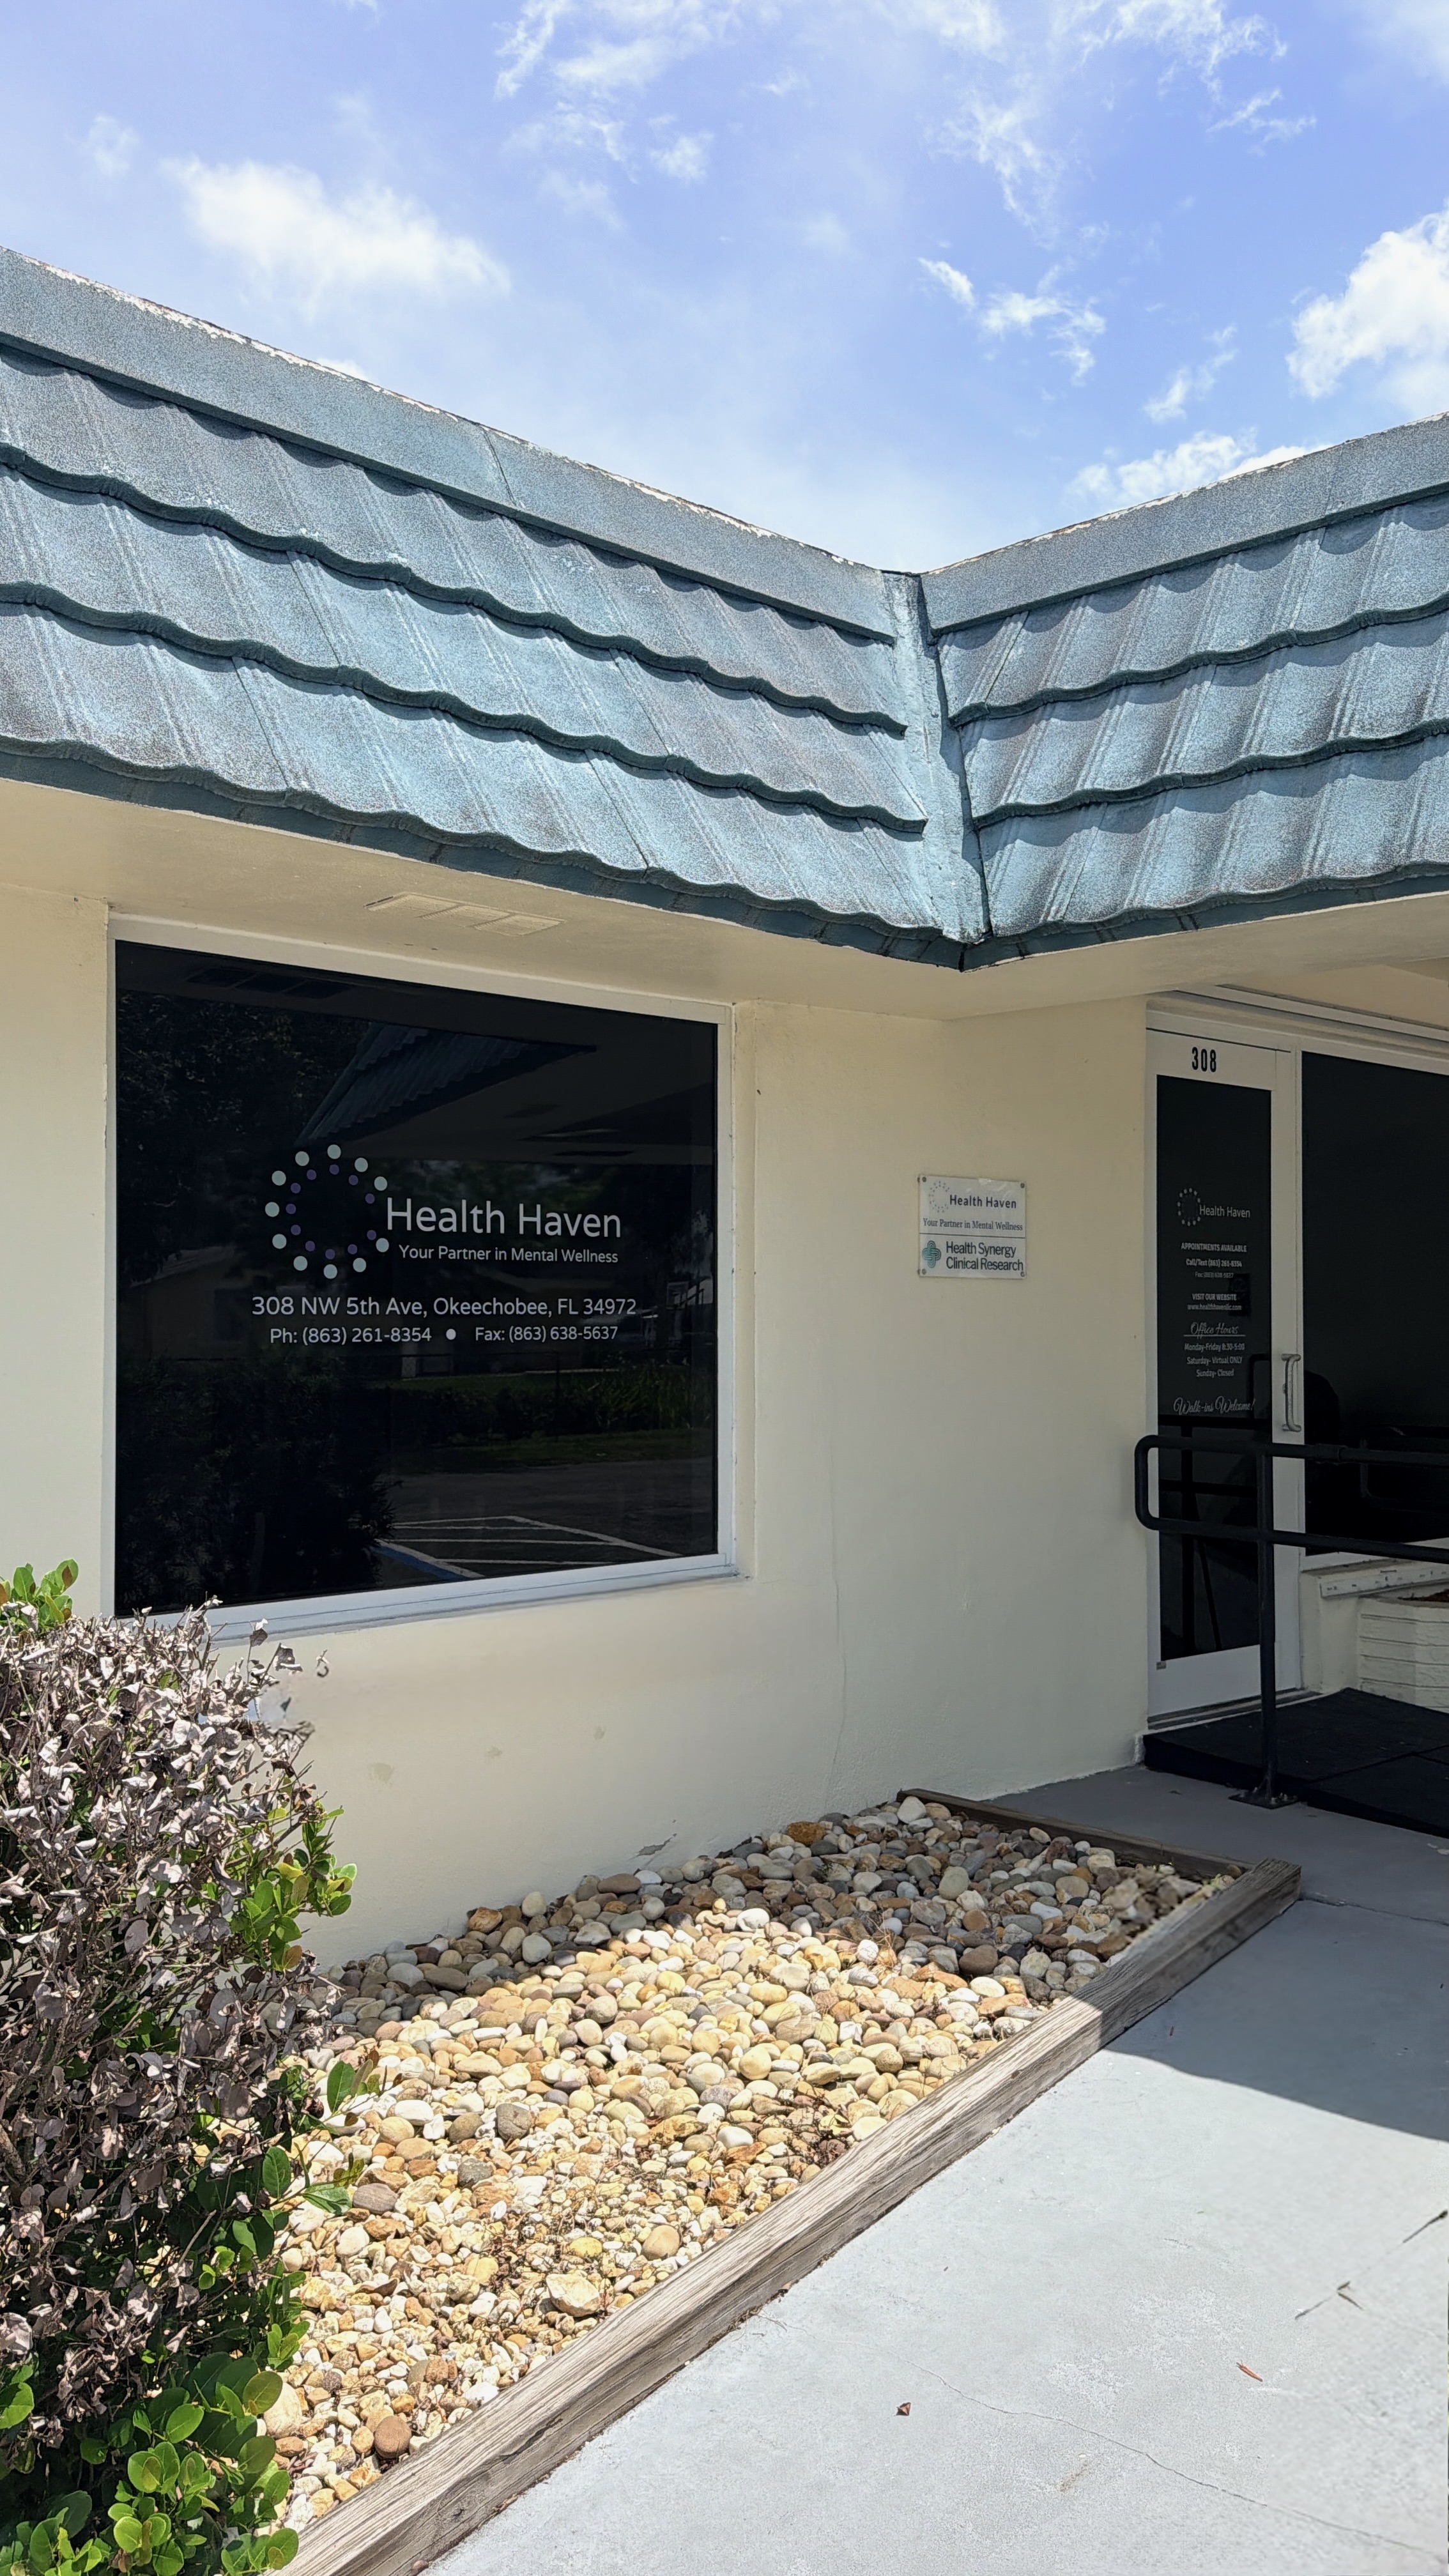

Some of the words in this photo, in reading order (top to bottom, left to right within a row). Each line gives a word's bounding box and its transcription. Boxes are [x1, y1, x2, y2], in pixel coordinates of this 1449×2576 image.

[1192, 1046, 1216, 1073] 308
[949, 1194, 983, 1207] Health
[986, 1197, 1016, 1209] Haven
[387, 1197, 505, 1234] Health
[519, 1203, 621, 1238] Haven
[1199, 1204, 1225, 1216] Health
[1227, 1206, 1250, 1218] Haven
[923, 1218, 938, 1227] Your
[939, 1219, 963, 1228] Partner
[972, 1221, 993, 1230] Mental
[995, 1222, 1023, 1230] Wellness
[399, 1245, 434, 1261] Your
[438, 1246, 491, 1261] Partner
[494, 1246, 507, 1261] in
[511, 1247, 558, 1262] Mental
[561, 1248, 618, 1263] Wellness
[946, 1241, 976, 1254] Health
[978, 1242, 1016, 1258] Synergy
[1181, 1243, 1220, 1252] APPOINTMENTS
[946, 1256, 979, 1269] Clinical
[980, 1257, 1023, 1271] Research
[1186, 1258, 1208, 1266] Call/Text
[252, 1296, 294, 1316] 308
[302, 1297, 341, 1315] NW
[346, 1297, 379, 1315] 5th
[386, 1298, 427, 1318] Ave,
[433, 1298, 553, 1318] Okeechobee,
[558, 1299, 579, 1315] FL
[583, 1298, 637, 1316] 34972
[270, 1329, 298, 1344] Ph:
[302, 1328, 347, 1345] (863)
[351, 1328, 432, 1343] 261-8354
[475, 1327, 505, 1341] Fax:
[509, 1326, 547, 1342] (863)
[550, 1326, 618, 1340] 638-5637
[1190, 1322, 1214, 1339] Office
[1215, 1322, 1239, 1335] Hours
[1184, 1343, 1221, 1353] Monday-Friday
[1186, 1356, 1211, 1366] Saturday-
[1196, 1368, 1216, 1378] Sunday-
[1217, 1368, 1234, 1377] Closed
[1173, 1397, 1214, 1415] Walk-ins
[1215, 1395, 1256, 1414] Welcome!
